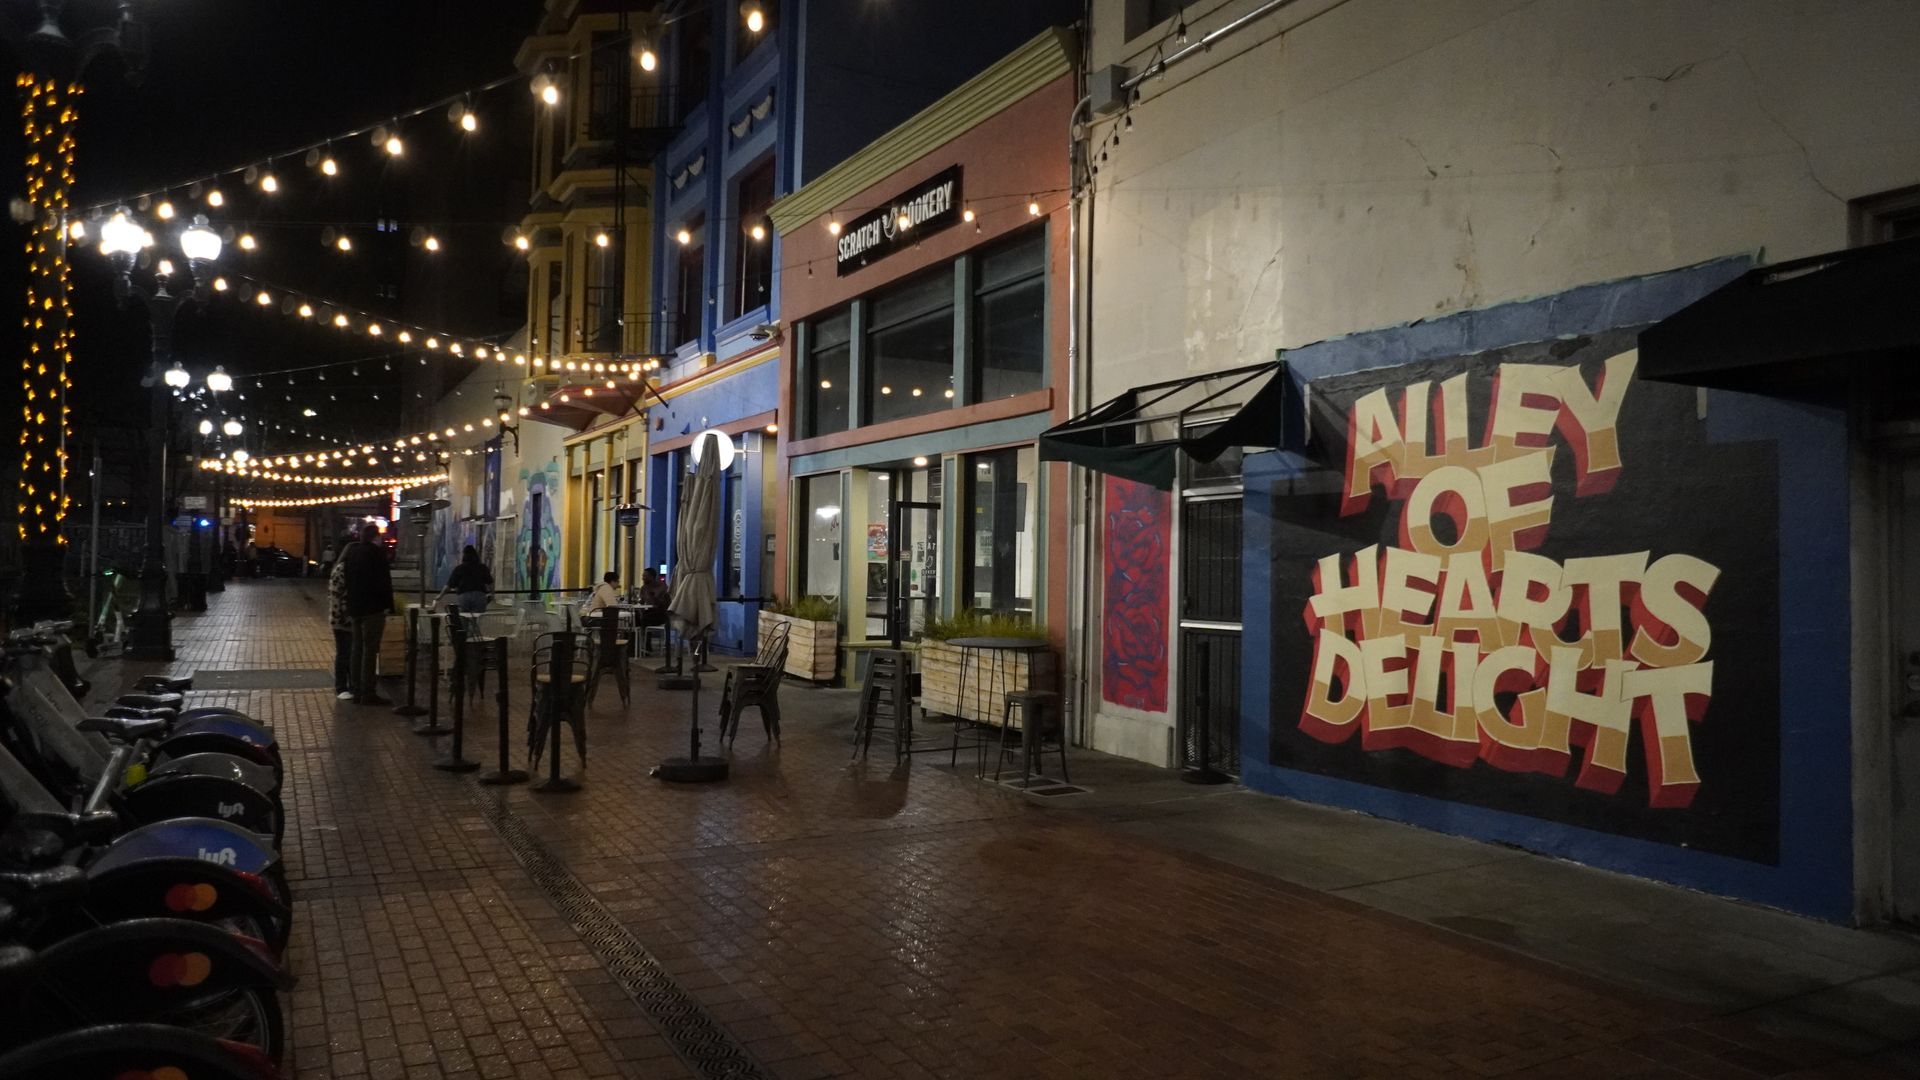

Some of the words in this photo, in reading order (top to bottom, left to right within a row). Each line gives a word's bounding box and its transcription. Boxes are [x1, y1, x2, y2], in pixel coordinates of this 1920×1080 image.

[838, 219, 880, 262] SCRATCH
[1338, 348, 1639, 516] ALLEY
[1400, 446, 1557, 571] OF
[1304, 543, 1721, 670] HEARTS
[1298, 628, 1714, 807] DELIGHT
[218, 801, 245, 818] lyft
